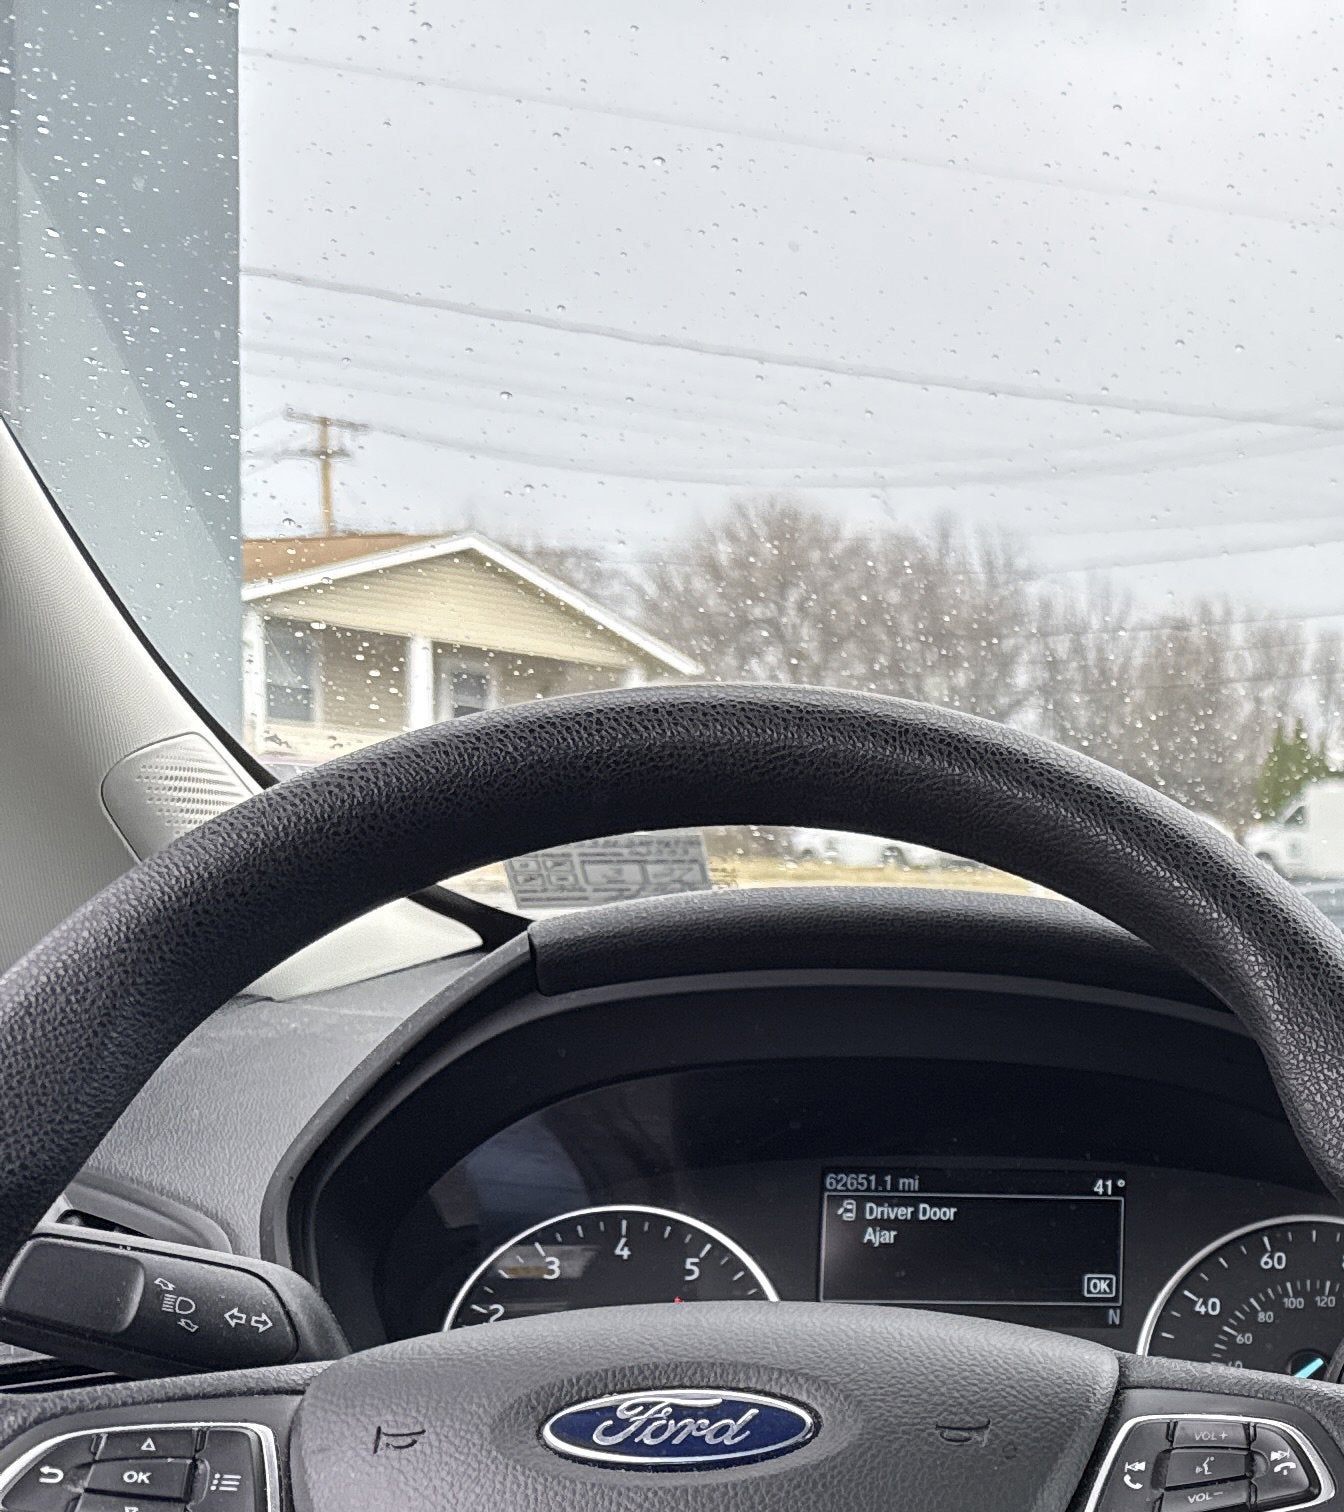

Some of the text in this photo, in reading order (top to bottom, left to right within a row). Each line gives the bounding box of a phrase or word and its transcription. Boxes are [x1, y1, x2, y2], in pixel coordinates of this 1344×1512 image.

[825, 1173, 921, 1192] 62651.1 mi
[865, 1202, 957, 1222] Driver Door
[863, 1226, 898, 1248] Ajar
[613, 1237, 632, 1261] 4
[543, 1256, 562, 1281] 3
[683, 1256, 701, 1282] 5
[1260, 1251, 1288, 1271] 60
[1089, 1278, 1112, 1294] OK
[1194, 1297, 1222, 1317] 40
[1283, 1297, 1306, 1310] 100
[1315, 1295, 1337, 1308] 120
[1107, 1308, 1121, 1326] N
[1257, 1310, 1274, 1324] 80
[1236, 1332, 1253, 1345] 60
[592, 1396, 760, 1447] Ford
[123, 1469, 152, 1485] OK
